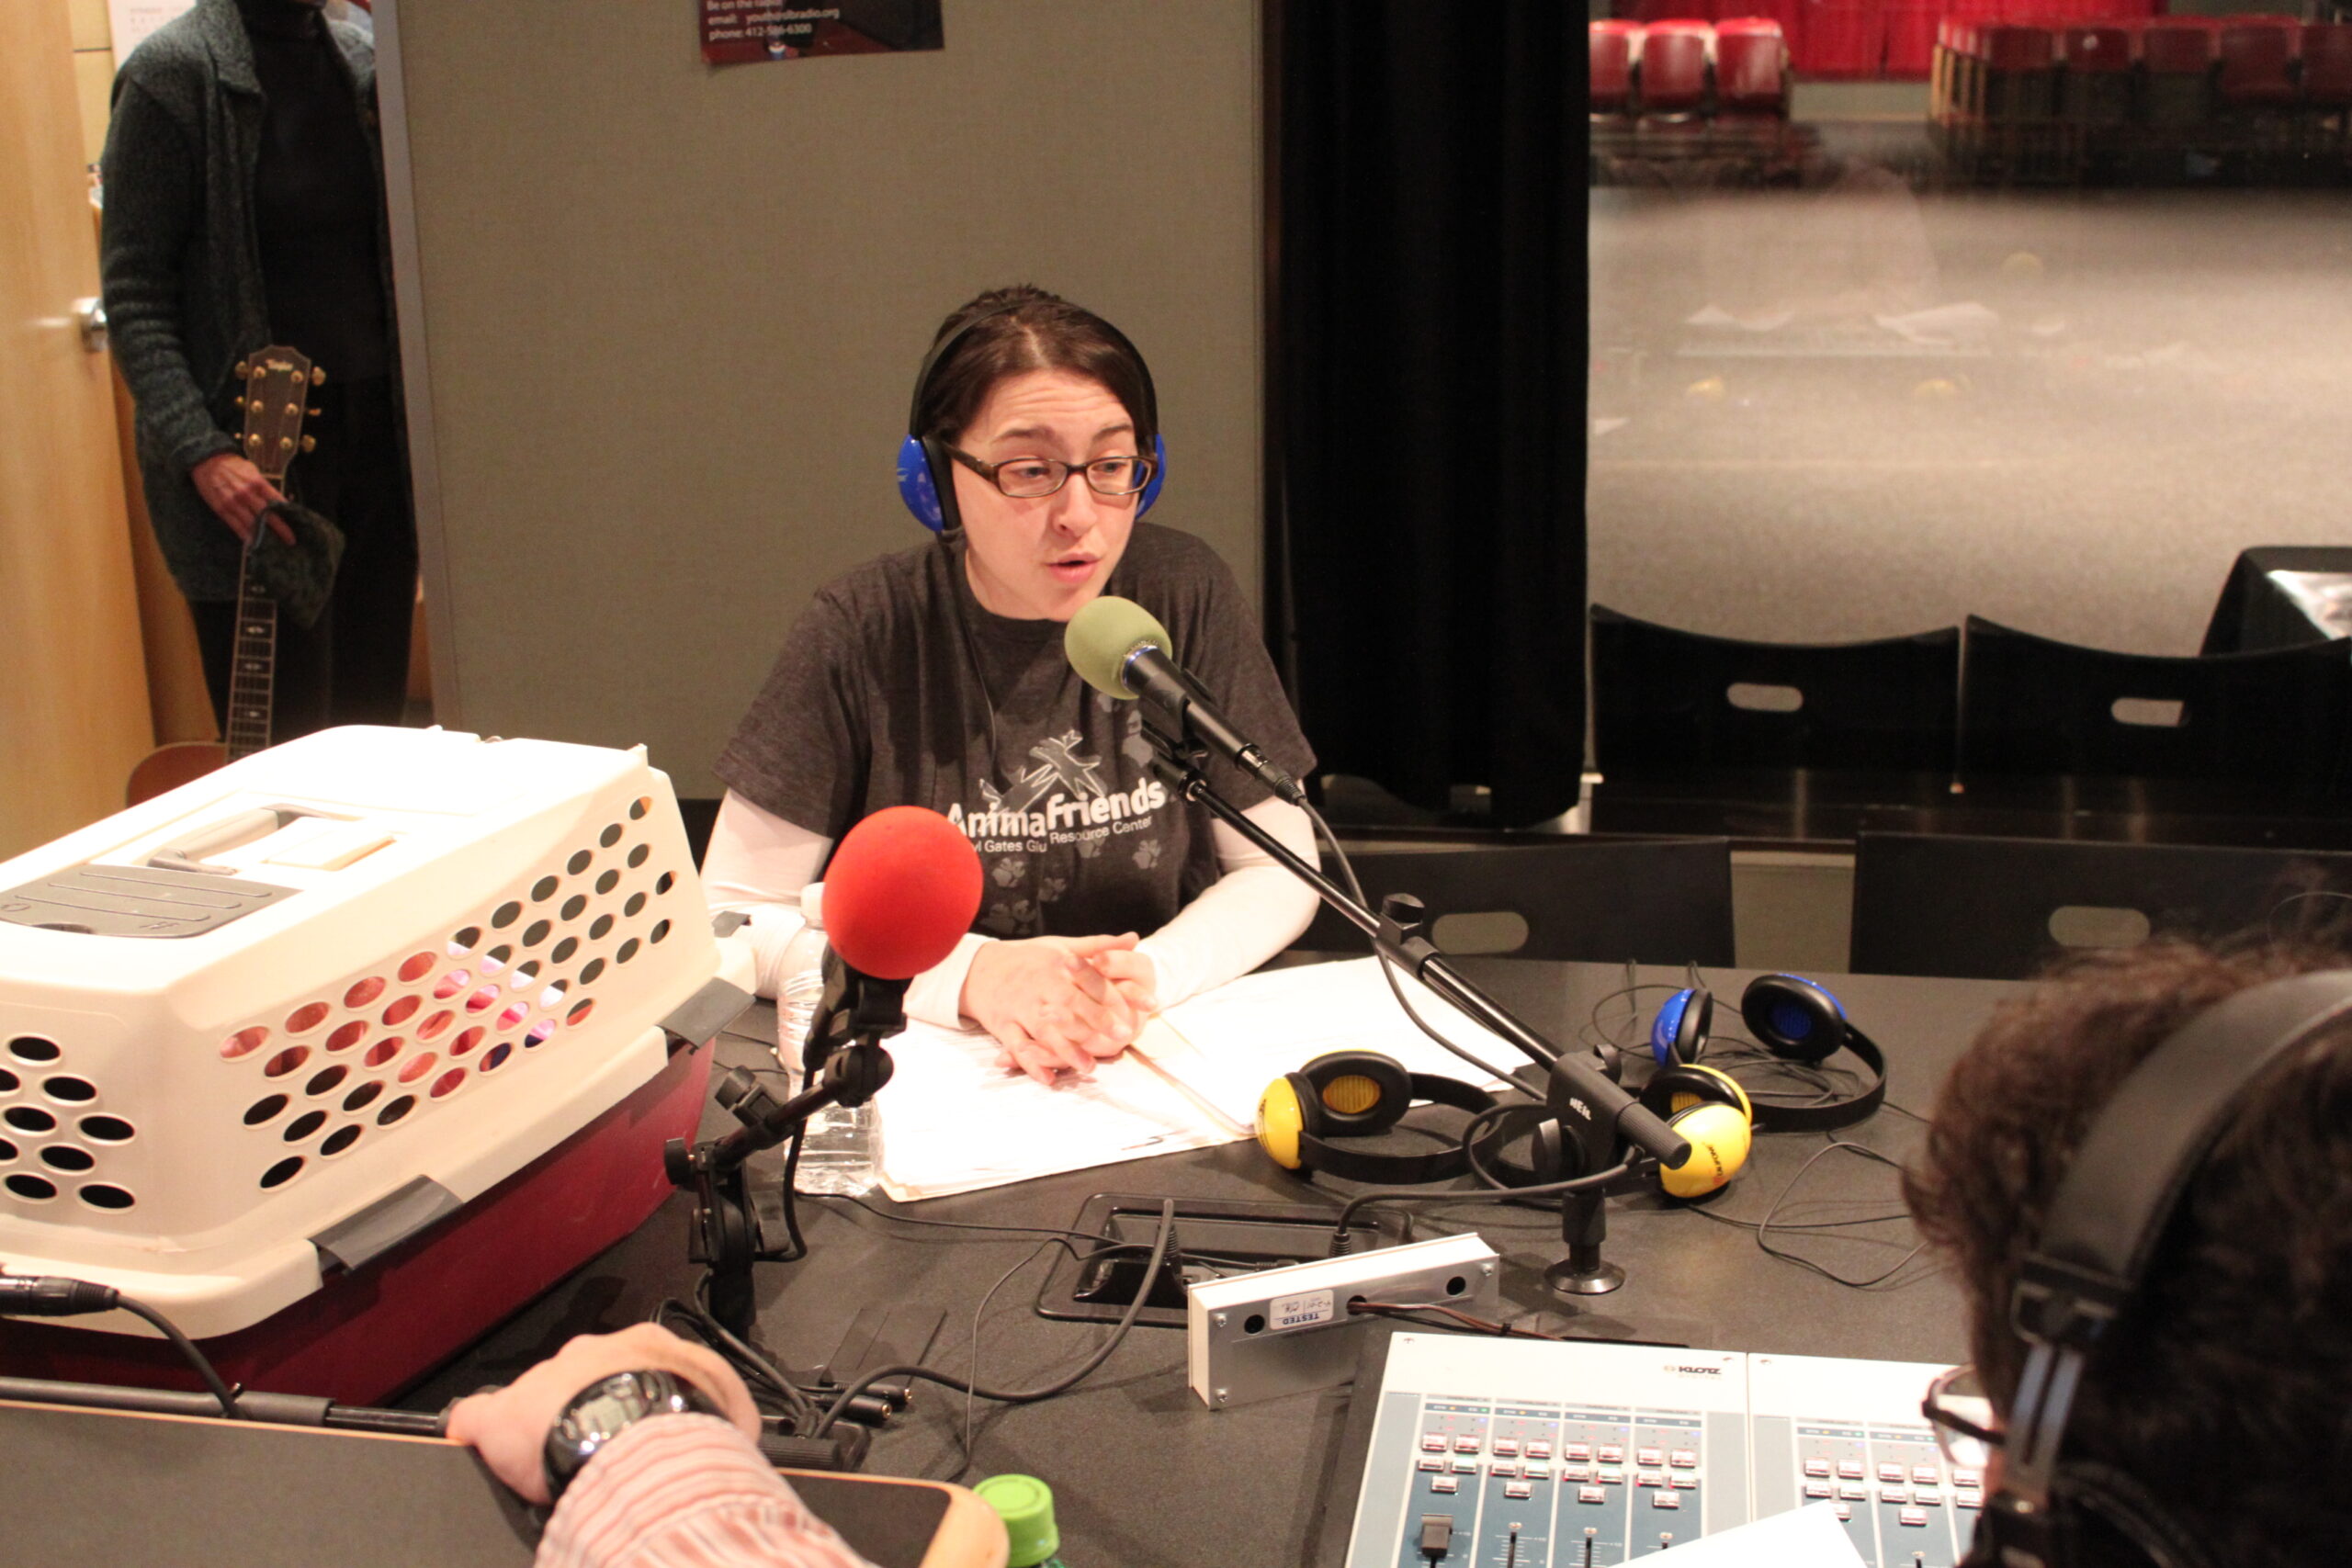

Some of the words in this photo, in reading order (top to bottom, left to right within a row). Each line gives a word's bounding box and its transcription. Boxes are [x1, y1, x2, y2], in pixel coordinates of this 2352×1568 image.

[984, 839, 1023, 852] Gates
[1049, 824, 1110, 844] Resource
[1112, 814, 1152, 834] Center
[1283, 1313, 1319, 1325] TESTED
[1679, 1366, 1721, 1374] KLOTZ
